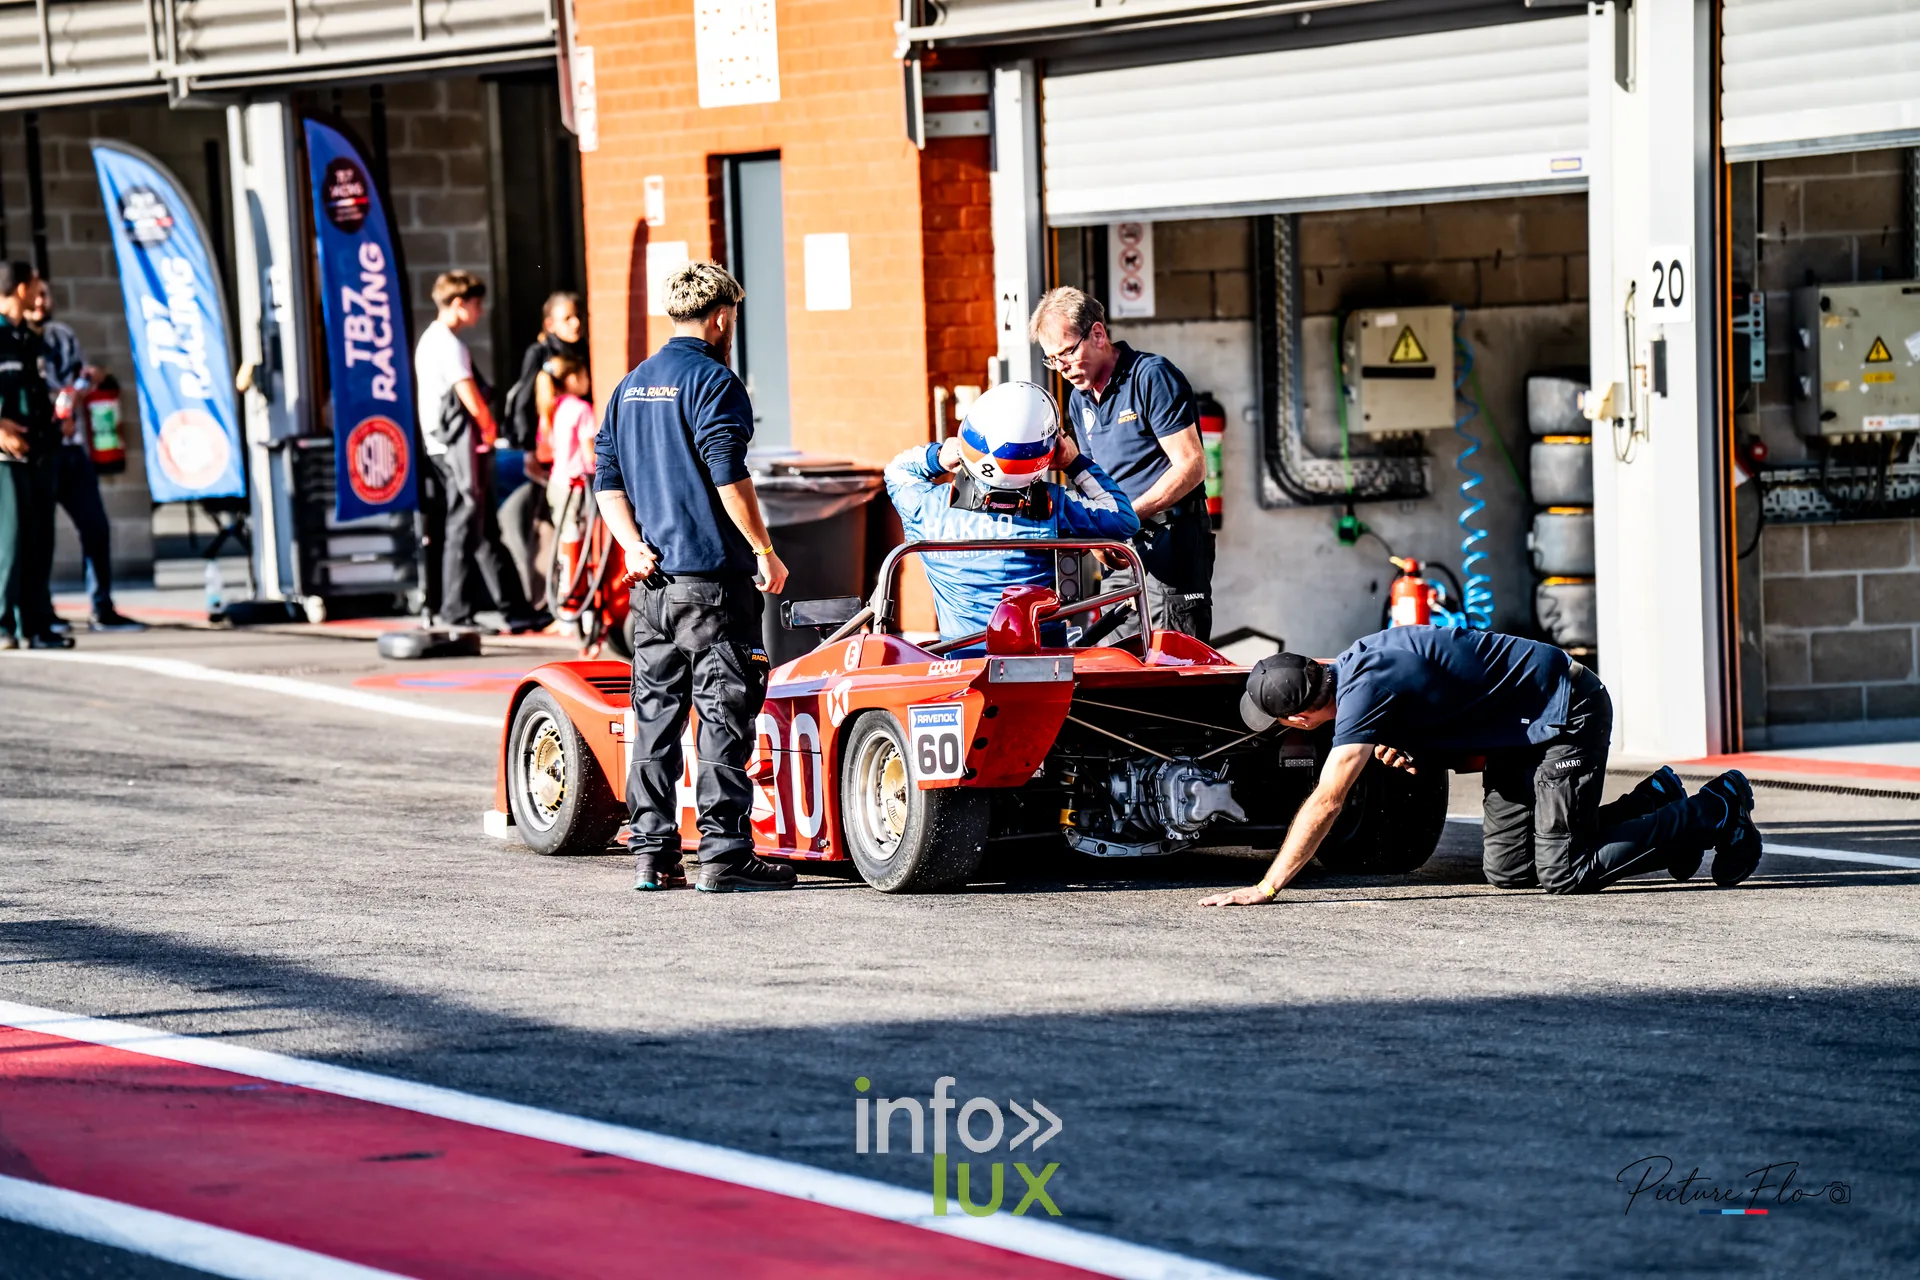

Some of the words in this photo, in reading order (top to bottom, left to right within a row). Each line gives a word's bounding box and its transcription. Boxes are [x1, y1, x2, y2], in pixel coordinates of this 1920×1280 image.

[1652, 259, 1684, 308] 20
[341, 285, 373, 368] TB7
[358, 242, 398, 402] RACING
[981, 463, 995, 478] 8
[925, 513, 1013, 540] HAKRO
[917, 713, 955, 724] RAVENOL
[917, 732, 959, 775] 60
[1555, 759, 1581, 770] HAKRO
